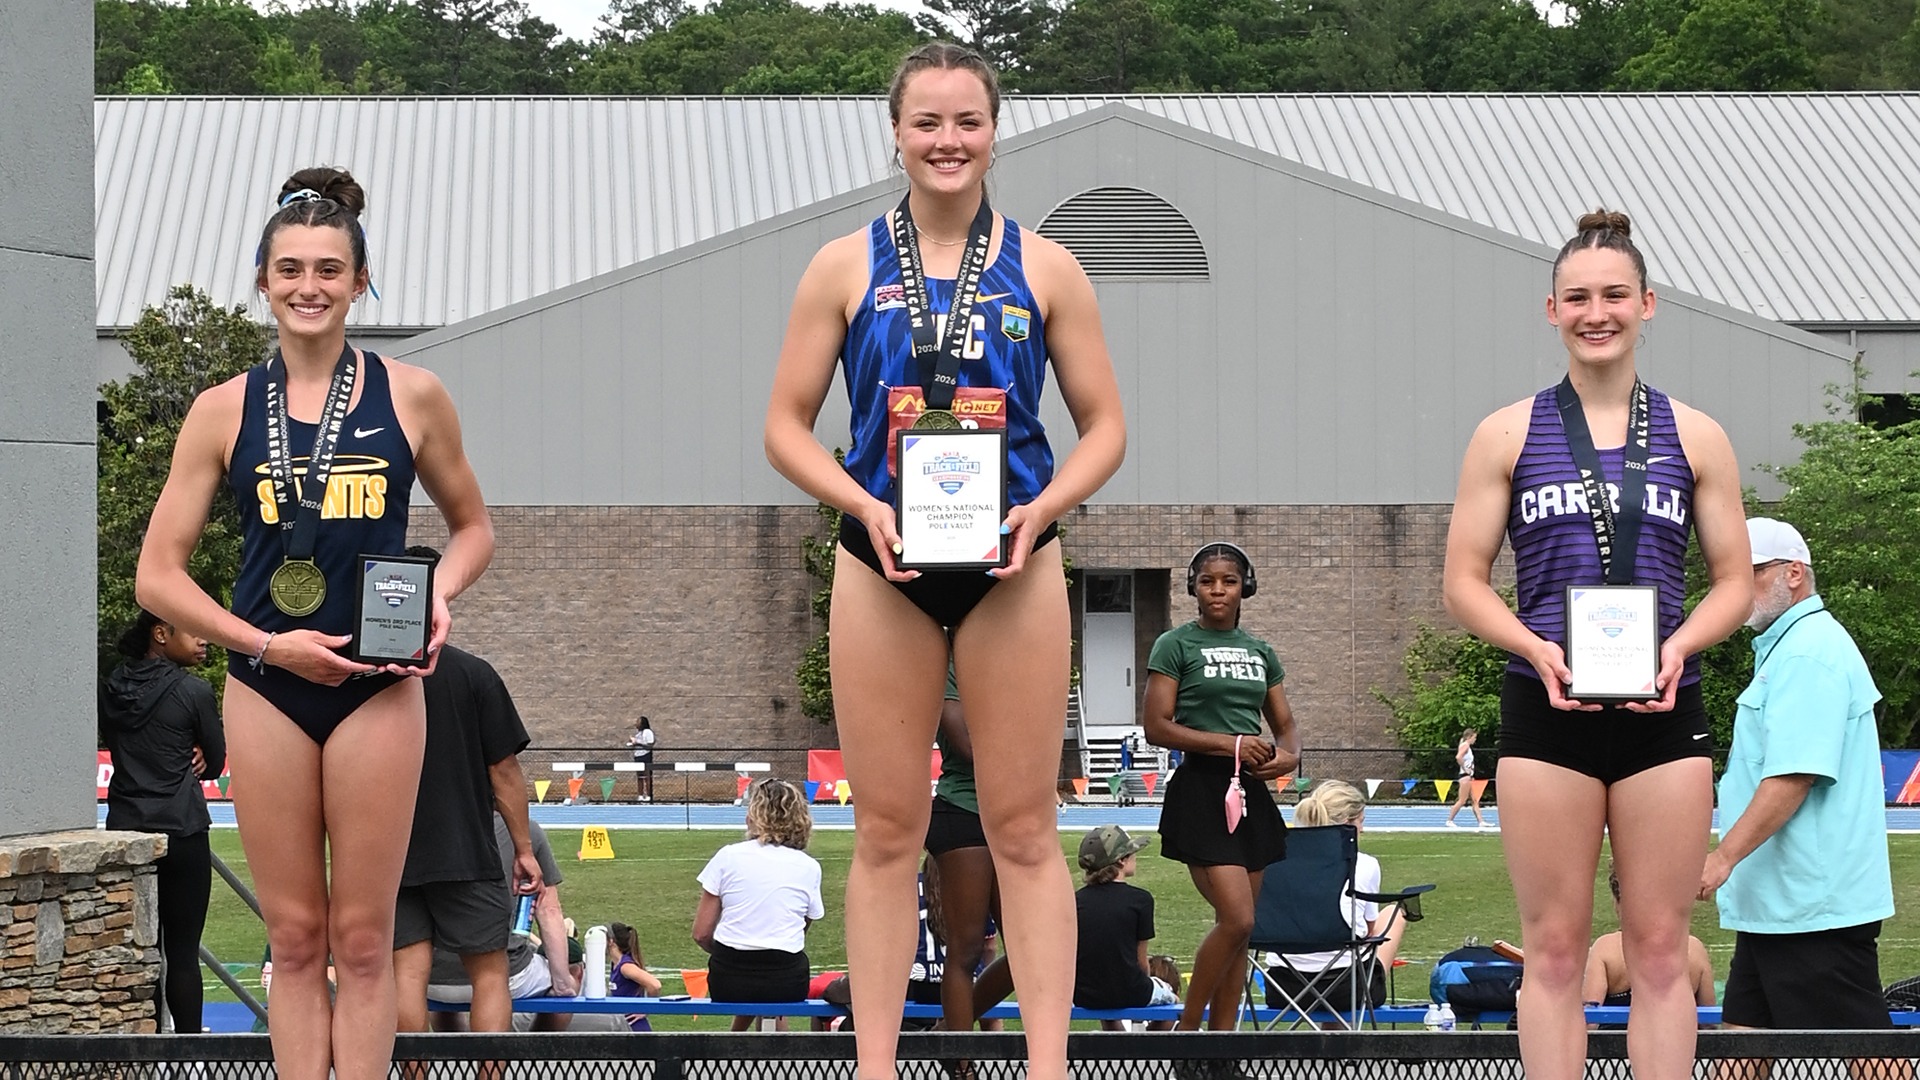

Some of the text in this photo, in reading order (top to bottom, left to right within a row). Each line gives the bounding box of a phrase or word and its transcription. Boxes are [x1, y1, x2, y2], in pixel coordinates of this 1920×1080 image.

[894, 211, 923, 328] ALL-AMERICAN
[950, 234, 988, 358] ALL-AMERICAN
[950, 289, 962, 320] OUTDOOR
[917, 344, 938, 354] 2026
[934, 374, 956, 386] 2026
[974, 403, 997, 412] NET
[316, 364, 356, 484] ALL-AMERICAN
[268, 382, 288, 504] ALL-AMERICAN
[1624, 460, 1646, 471] 2026
[256, 474, 388, 525] SNTS
[300, 499, 322, 511] 2026
[1521, 483, 1686, 526] CARRLL
[908, 504, 994, 513] WOMEN'S NATIONAL
[926, 512, 974, 521] CHAMPION
[282, 520, 296, 531] 20
[929, 522, 974, 530] POLE VAULT
